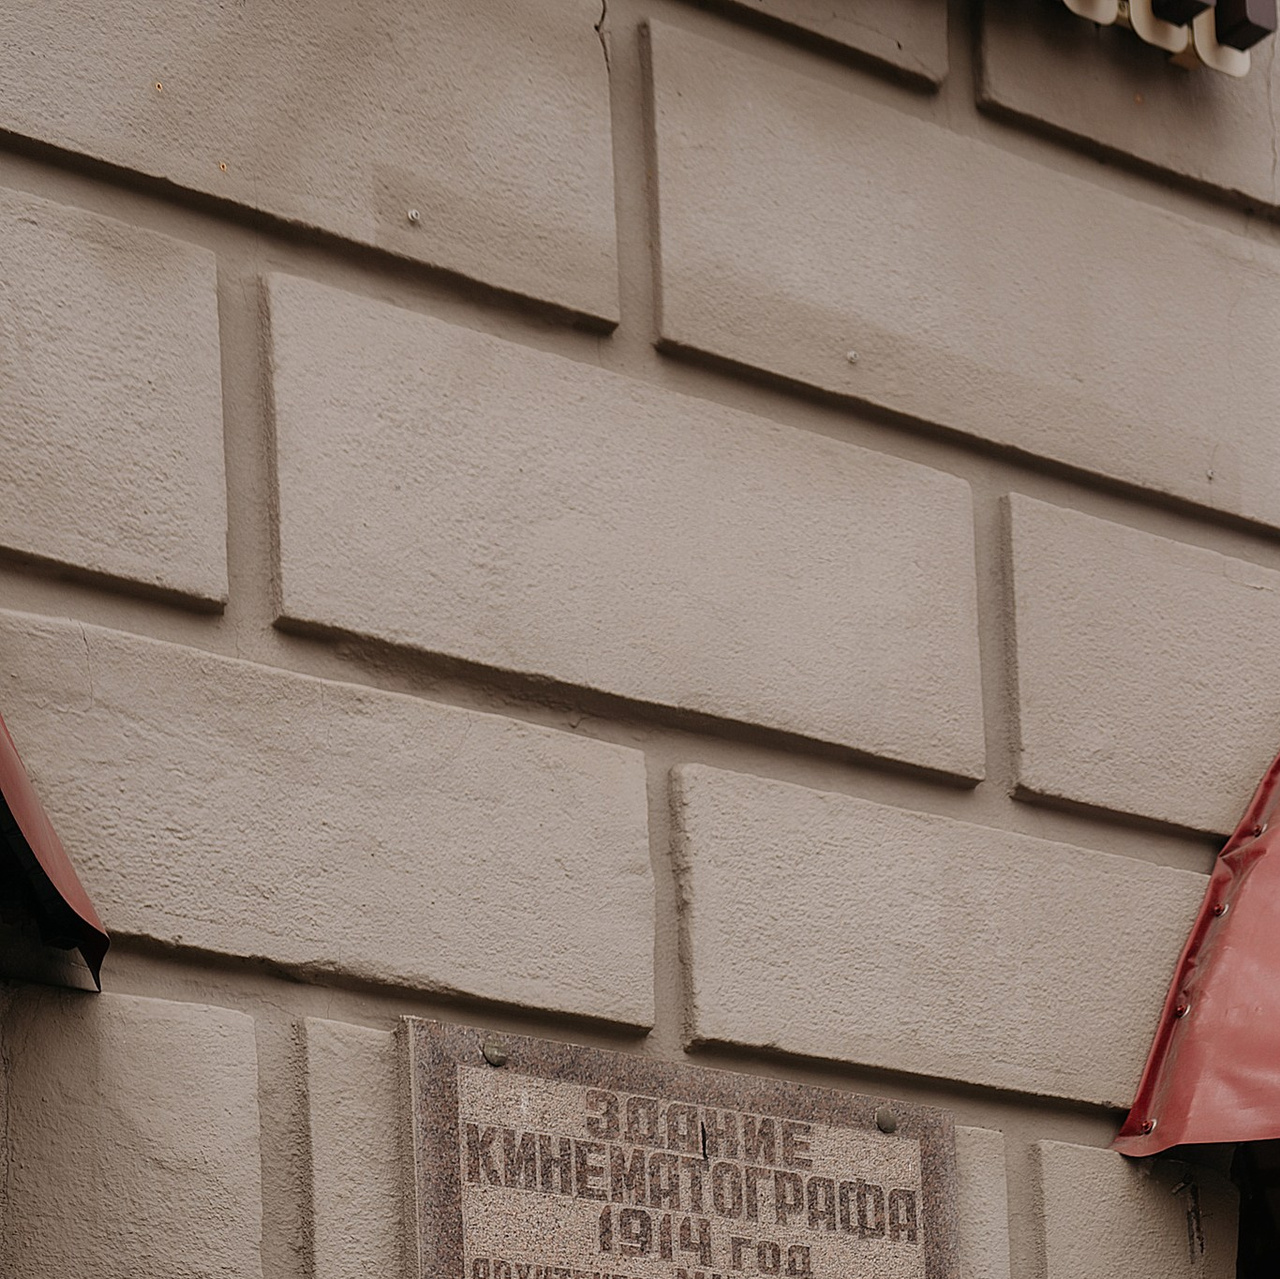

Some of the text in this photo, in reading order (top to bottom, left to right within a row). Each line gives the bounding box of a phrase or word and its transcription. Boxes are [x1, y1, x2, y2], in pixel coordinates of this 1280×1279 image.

[585, 1089, 814, 1170] ЗДАНИЕ
[465, 1123, 918, 1243] КИНЕМАТОГРАФА
[598, 1205, 712, 1267] 1914
